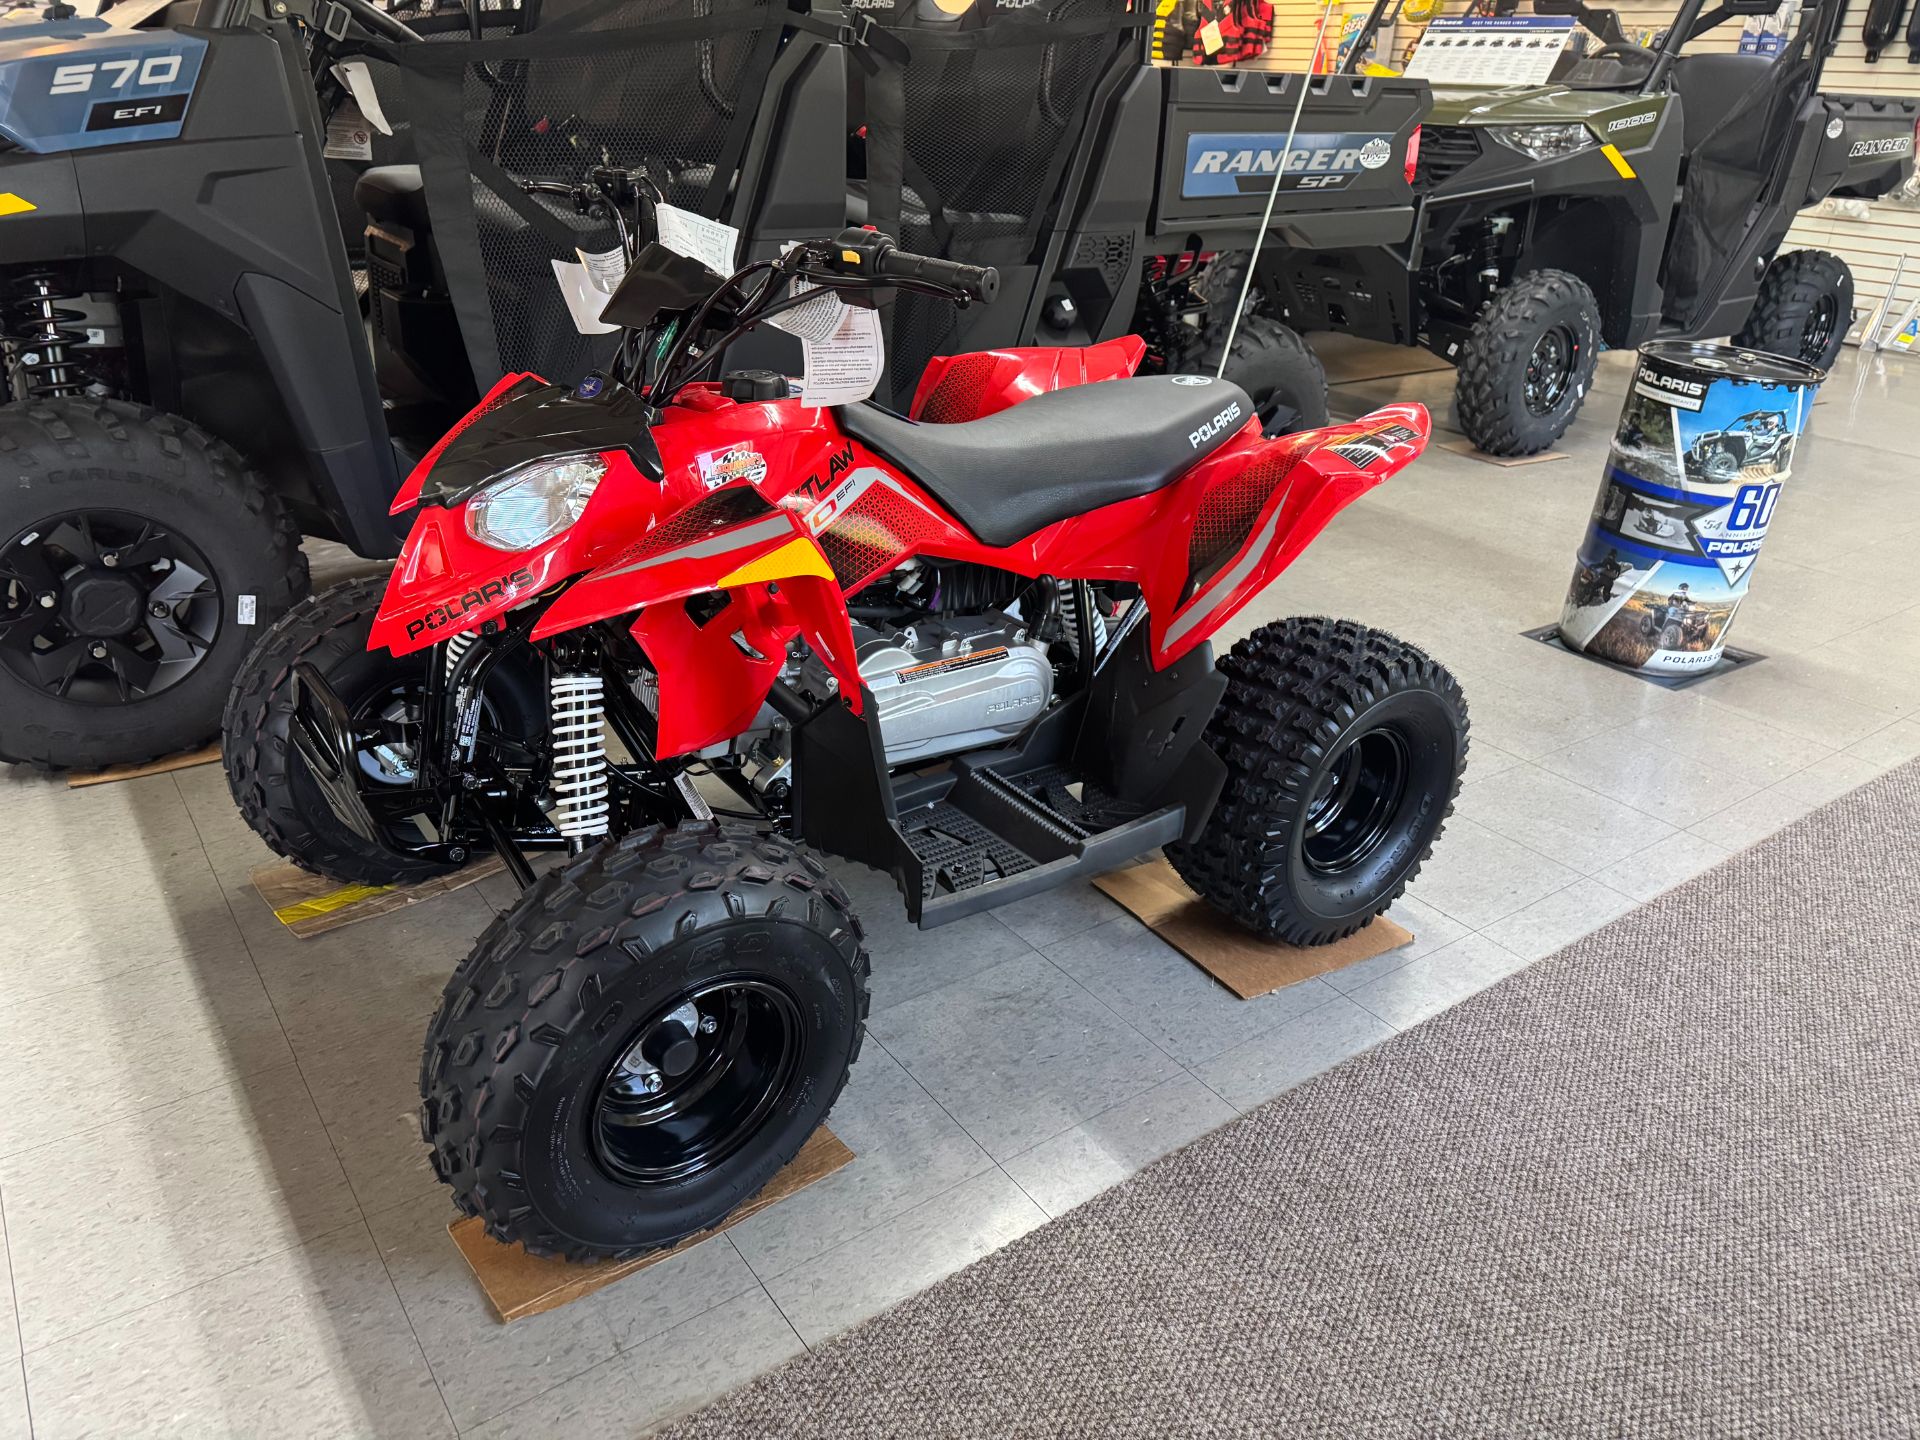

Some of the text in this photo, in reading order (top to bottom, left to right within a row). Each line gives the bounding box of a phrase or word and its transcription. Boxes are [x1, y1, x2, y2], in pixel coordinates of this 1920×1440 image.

[49, 55, 182, 95] 570
[113, 105, 162, 120] EFI
[1607, 111, 1657, 132] 1000
[1848, 137, 1910, 157] RANGER
[1192, 148, 1361, 175] RANGER
[1297, 175, 1344, 188] SP
[1638, 367, 1704, 396] POLARIS
[1188, 401, 1241, 449] POLARIS
[836, 479, 857, 501] EFI
[1727, 485, 1782, 531] 60
[405, 567, 535, 641] POLARIS
[986, 694, 1041, 715] POLARIS
